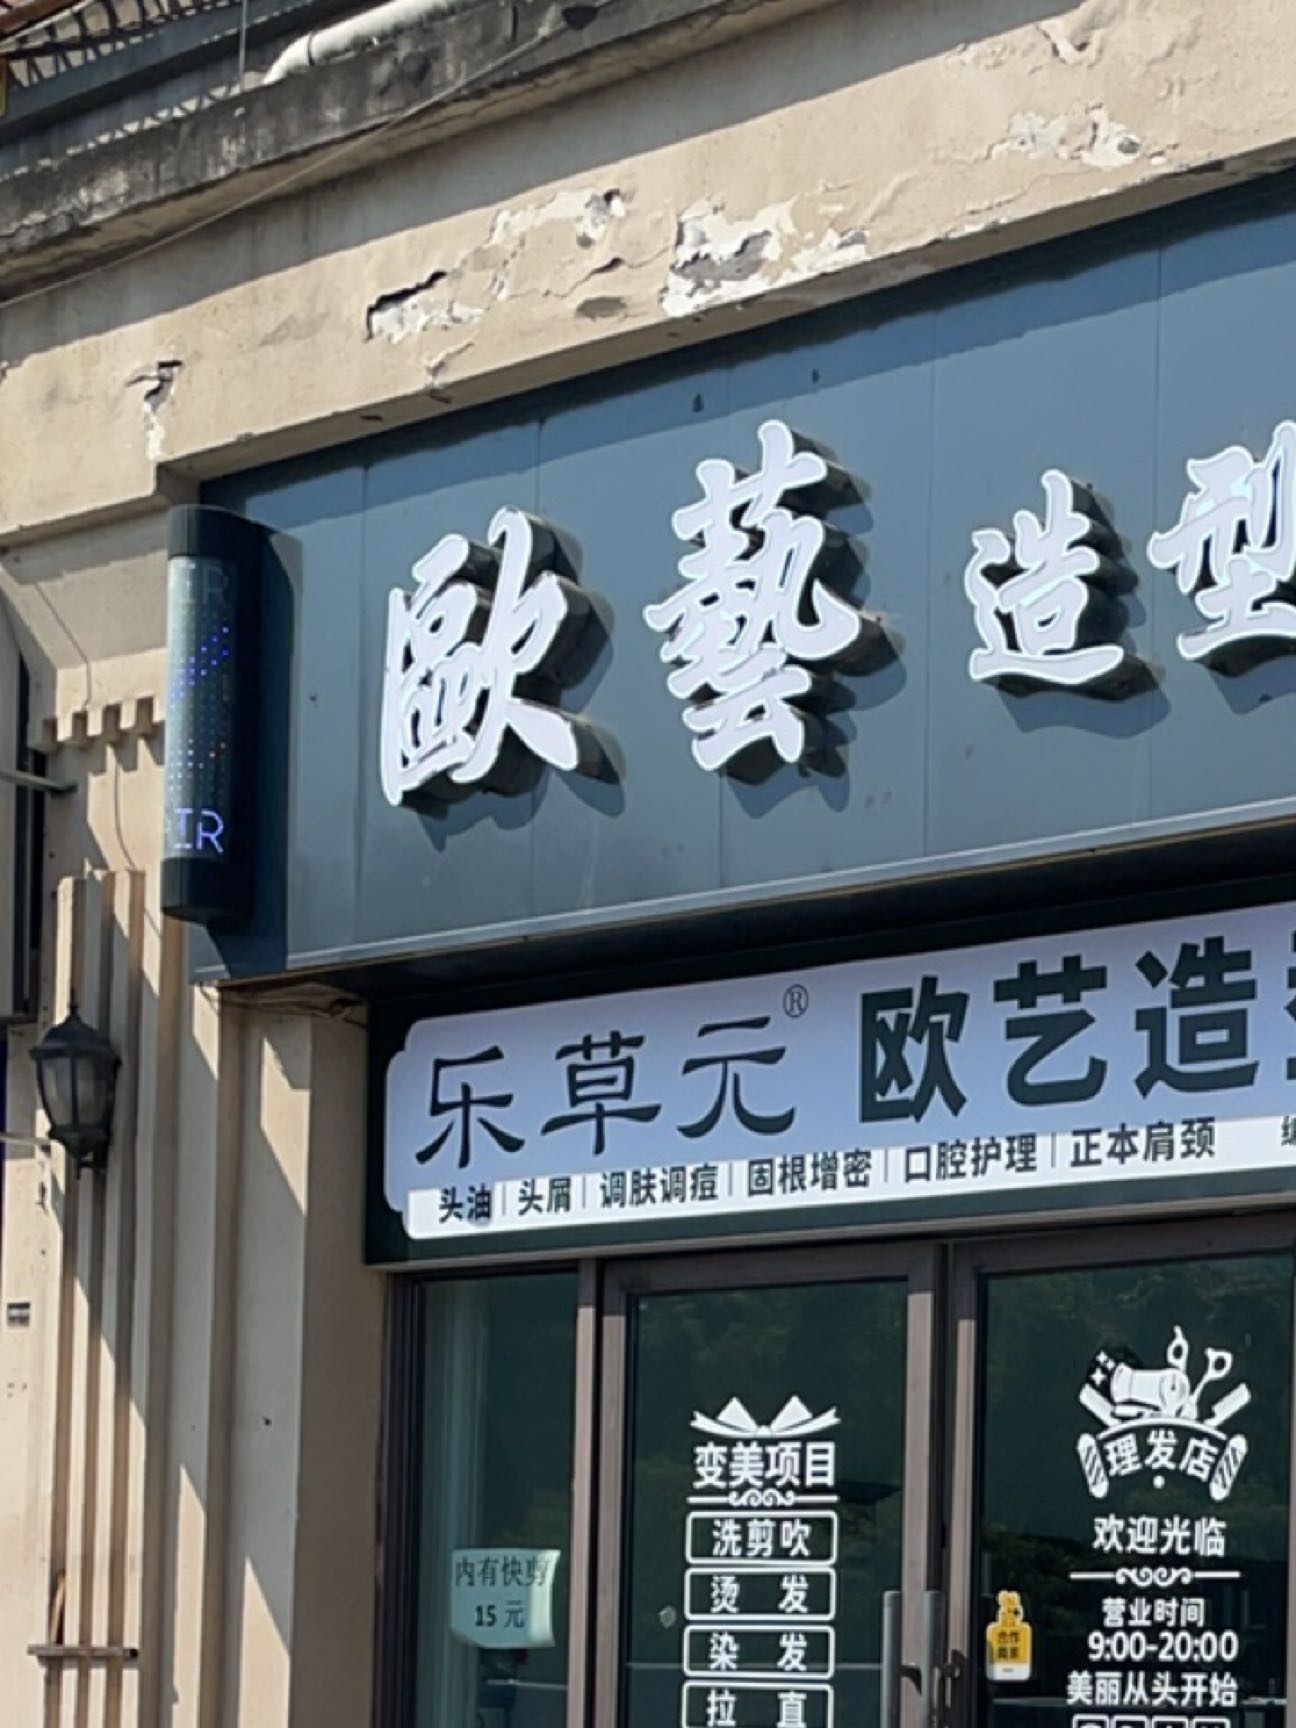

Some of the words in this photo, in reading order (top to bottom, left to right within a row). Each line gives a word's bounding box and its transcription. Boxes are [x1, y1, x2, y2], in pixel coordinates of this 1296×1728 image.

[415, 1015, 797, 1170] 乐草元
[438, 1183, 493, 1224] 头油
[517, 1176, 572, 1217] 头屑
[748, 1148, 872, 1198] 固根增密
[904, 1131, 1037, 1183] 口腔护理
[1070, 1115, 1216, 1168] 正本肩颈
[692, 1440, 837, 1489] 变美项目
[1105, 1428, 1223, 1482] 理发店
[711, 1518, 813, 1558] 洗剪吹
[1092, 1515, 1228, 1559] 欢迎光临
[1101, 1596, 1206, 1628] 营业时间
[1087, 1629, 1240, 1663] 9:00-20:00
[1065, 1669, 1239, 1709] 美丽从头开始
